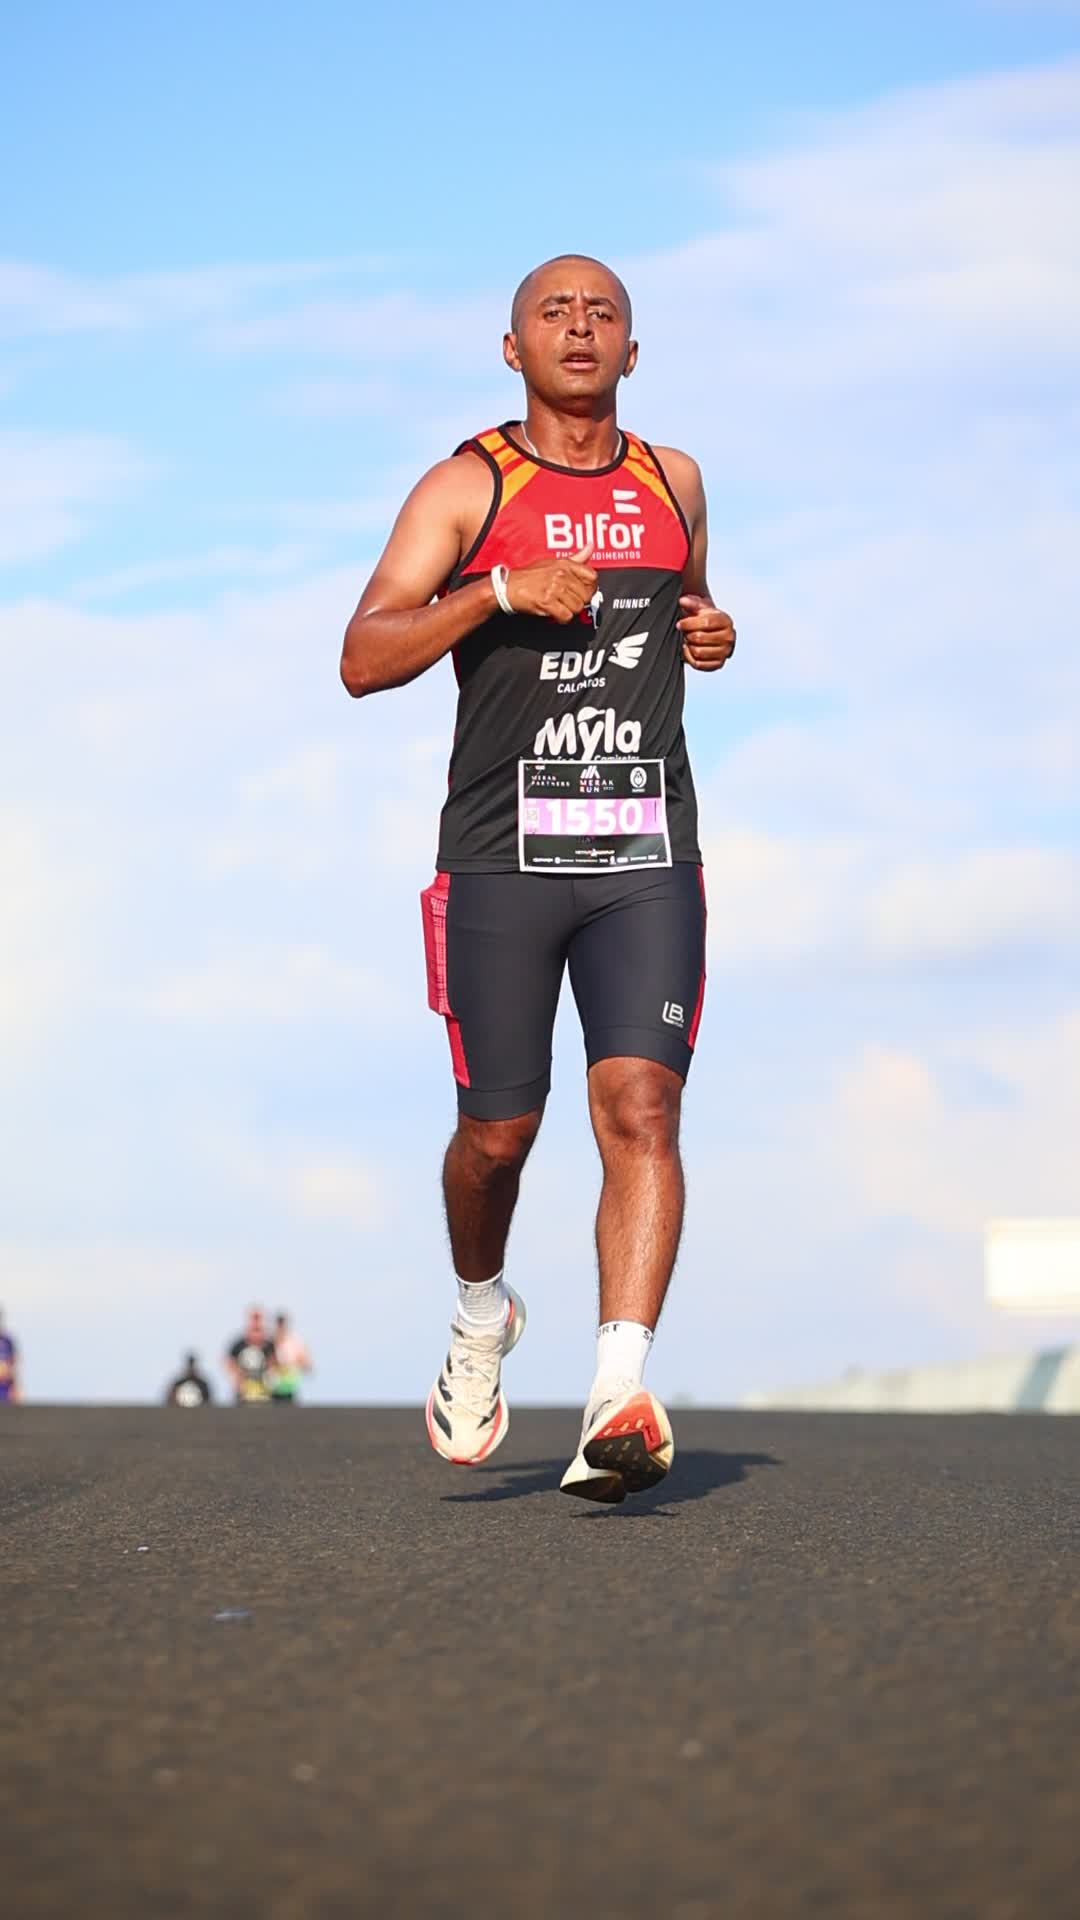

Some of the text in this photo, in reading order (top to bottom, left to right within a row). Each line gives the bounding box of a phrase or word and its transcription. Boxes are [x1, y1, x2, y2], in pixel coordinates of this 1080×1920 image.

[544, 513, 645, 549] Bilfor
[613, 598, 650, 609] RUNNER
[540, 650, 605, 680] EDU
[546, 799, 643, 835] 1550
